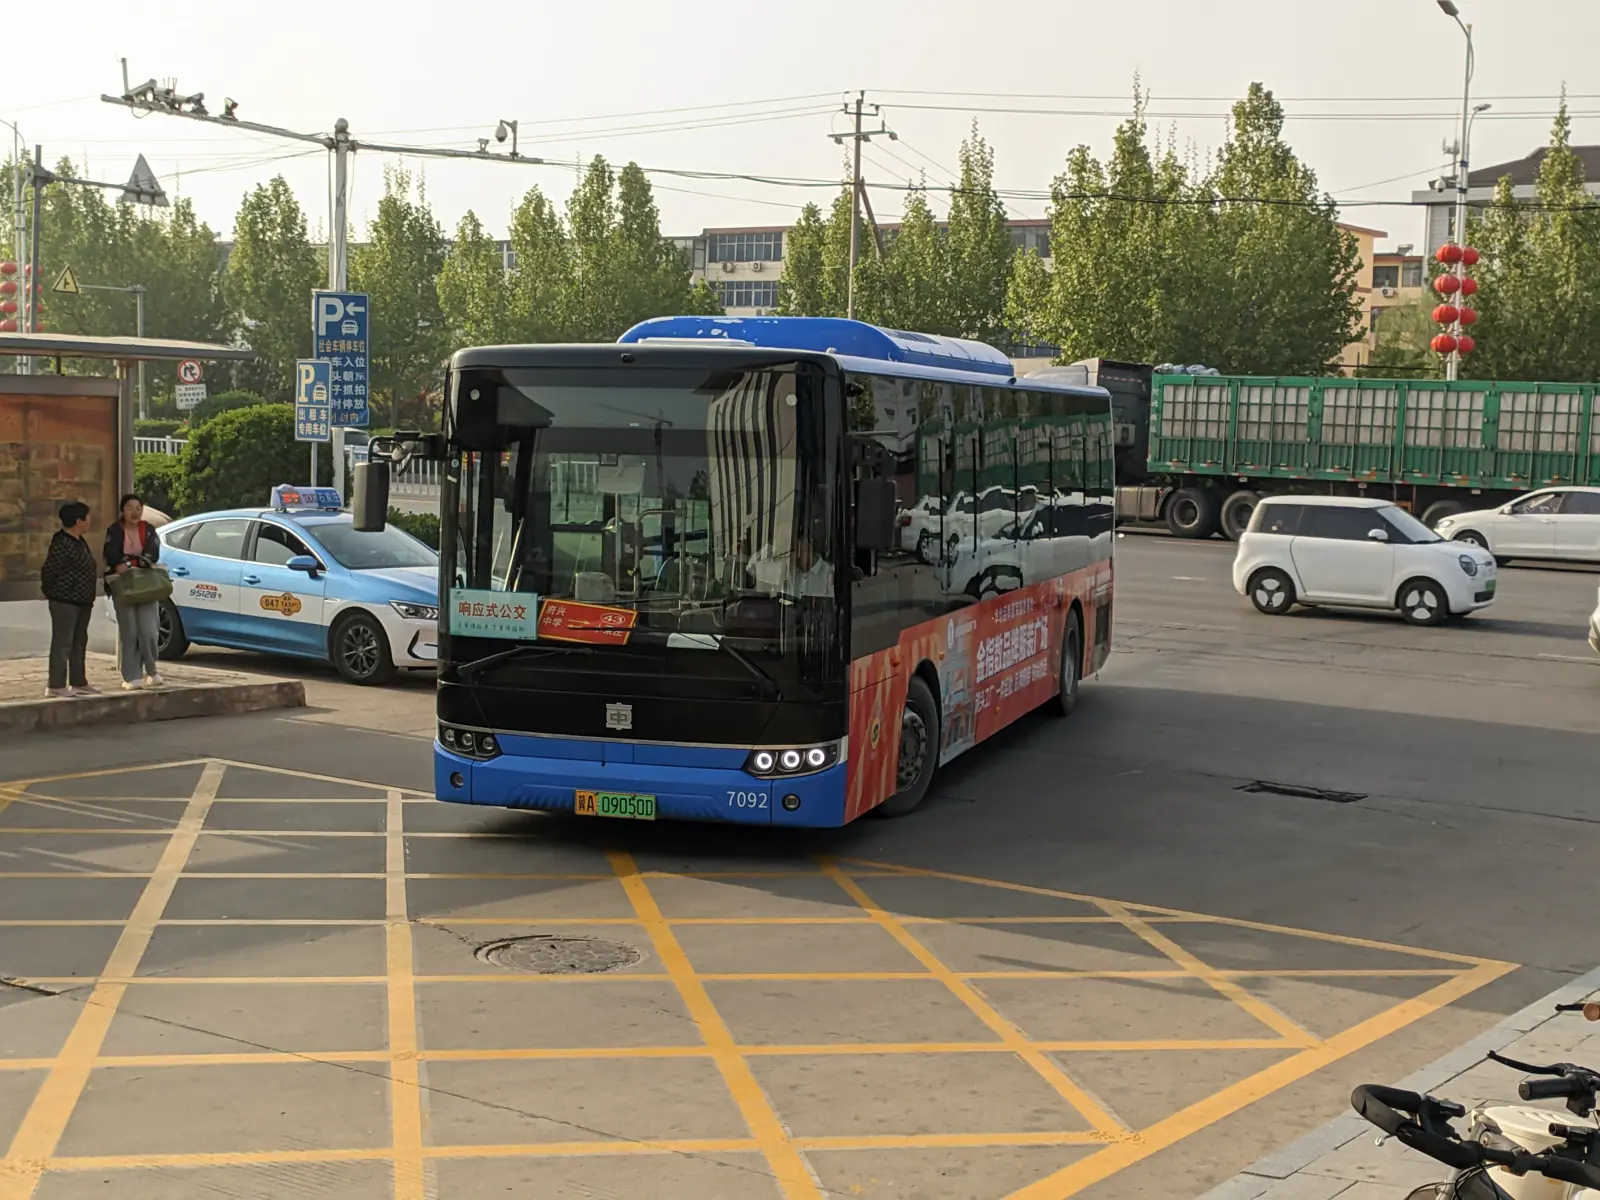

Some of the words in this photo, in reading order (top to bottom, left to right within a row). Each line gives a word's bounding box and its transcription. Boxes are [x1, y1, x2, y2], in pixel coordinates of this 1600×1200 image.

[319, 298, 344, 335] P
[319, 340, 365, 352] 社会车辆停车位
[299, 364, 315, 402] P
[299, 408, 327, 421] 出租车
[299, 423, 327, 435] 专用车位
[189, 589, 217, 599] 95128
[265, 598, 279, 607] 047
[458, 601, 526, 620] 响应式公交
[543, 617, 562, 627] 中学
[603, 615, 623, 624] 43
[726, 791, 768, 809] 7092
